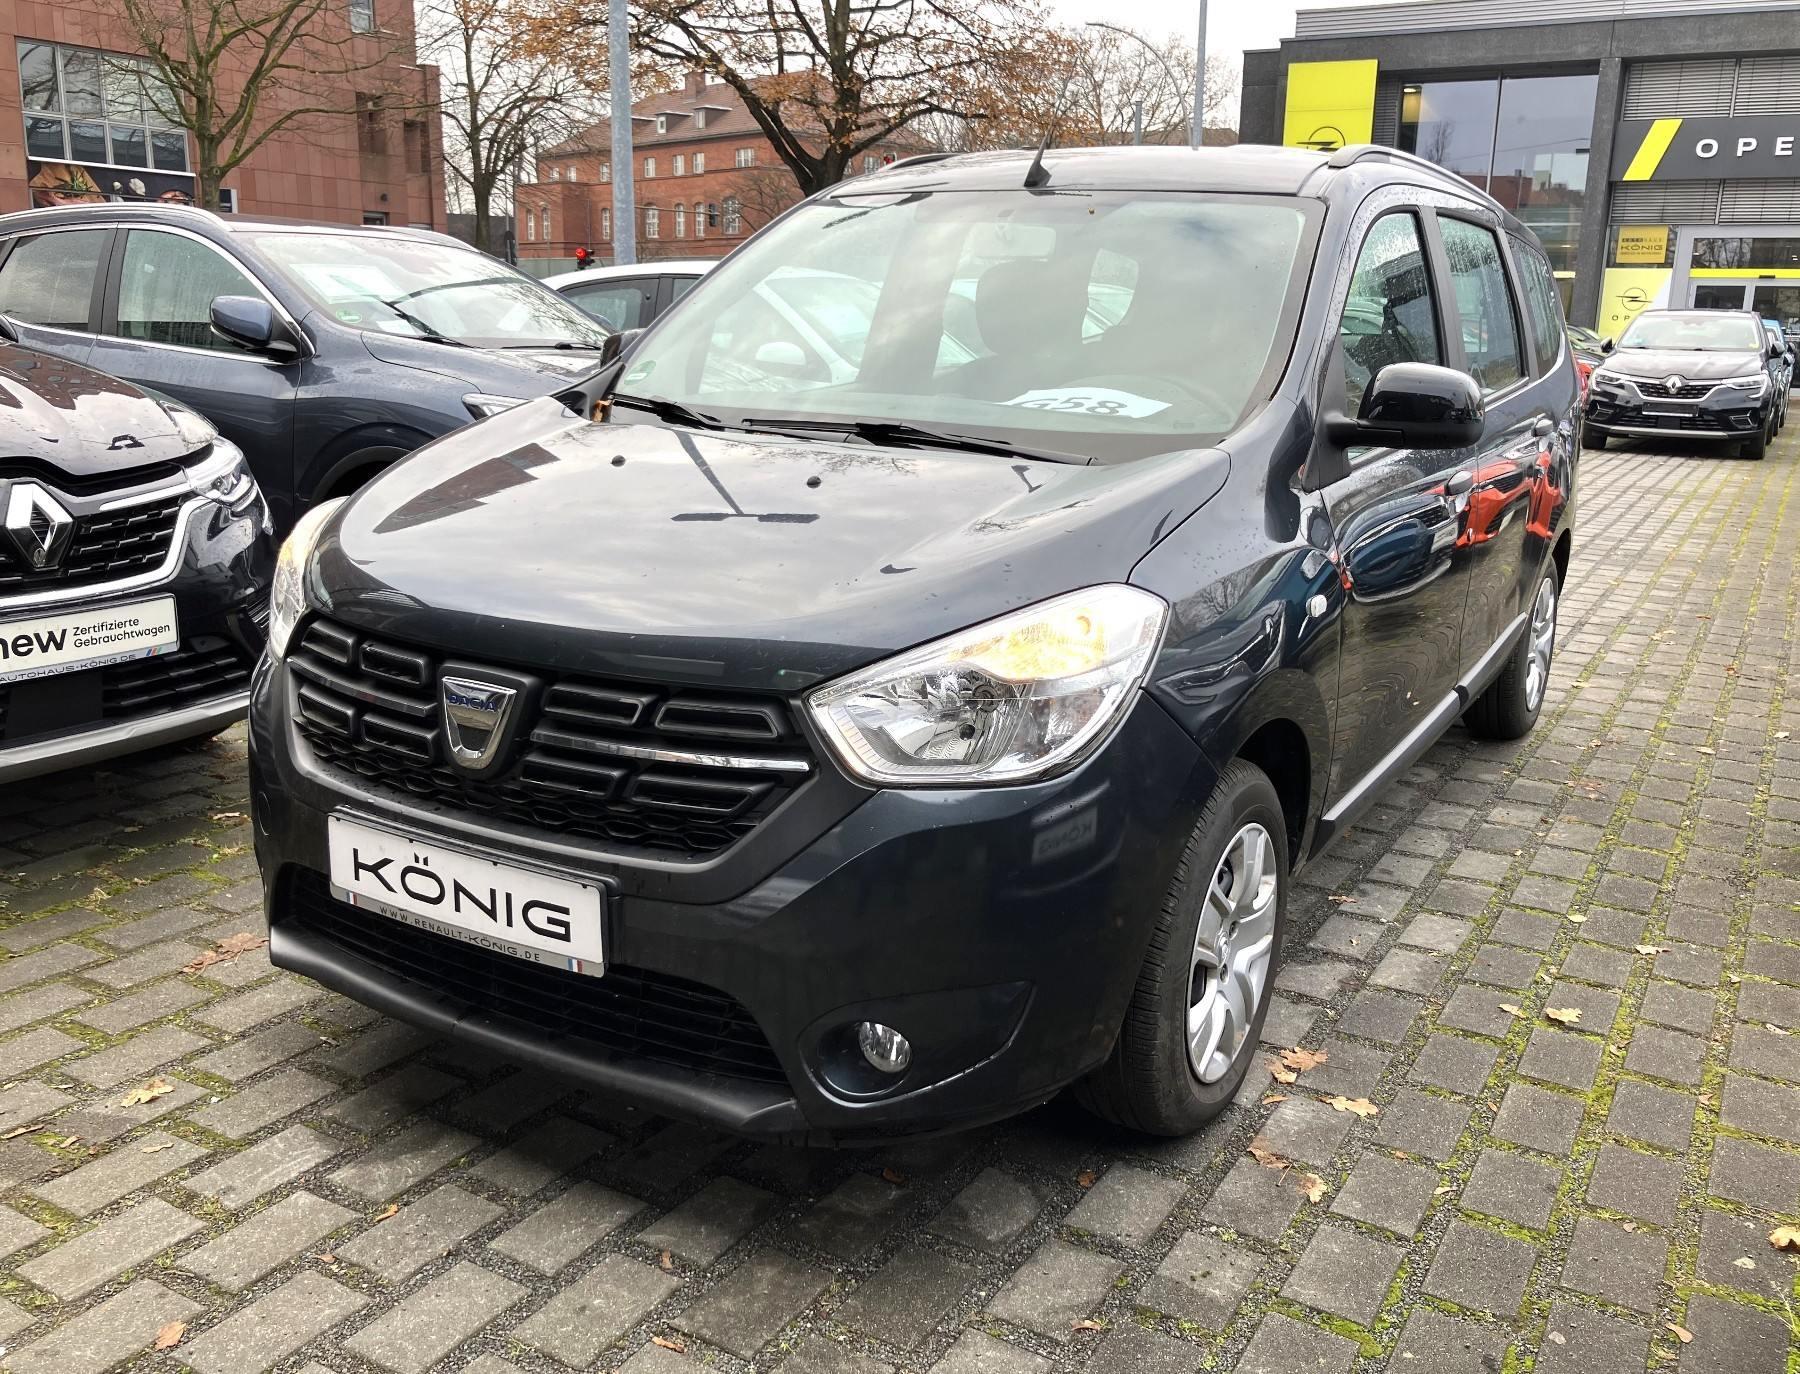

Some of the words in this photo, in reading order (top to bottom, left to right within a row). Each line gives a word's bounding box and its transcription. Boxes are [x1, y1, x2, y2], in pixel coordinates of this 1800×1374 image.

[73, 618, 139, 636] Zertifizierte
[74, 624, 170, 648] Gebrauchtwagen
[352, 847, 572, 942] KÖNIG
[379, 905, 541, 962] WWW.RENAULT-KÖNIG.DE
